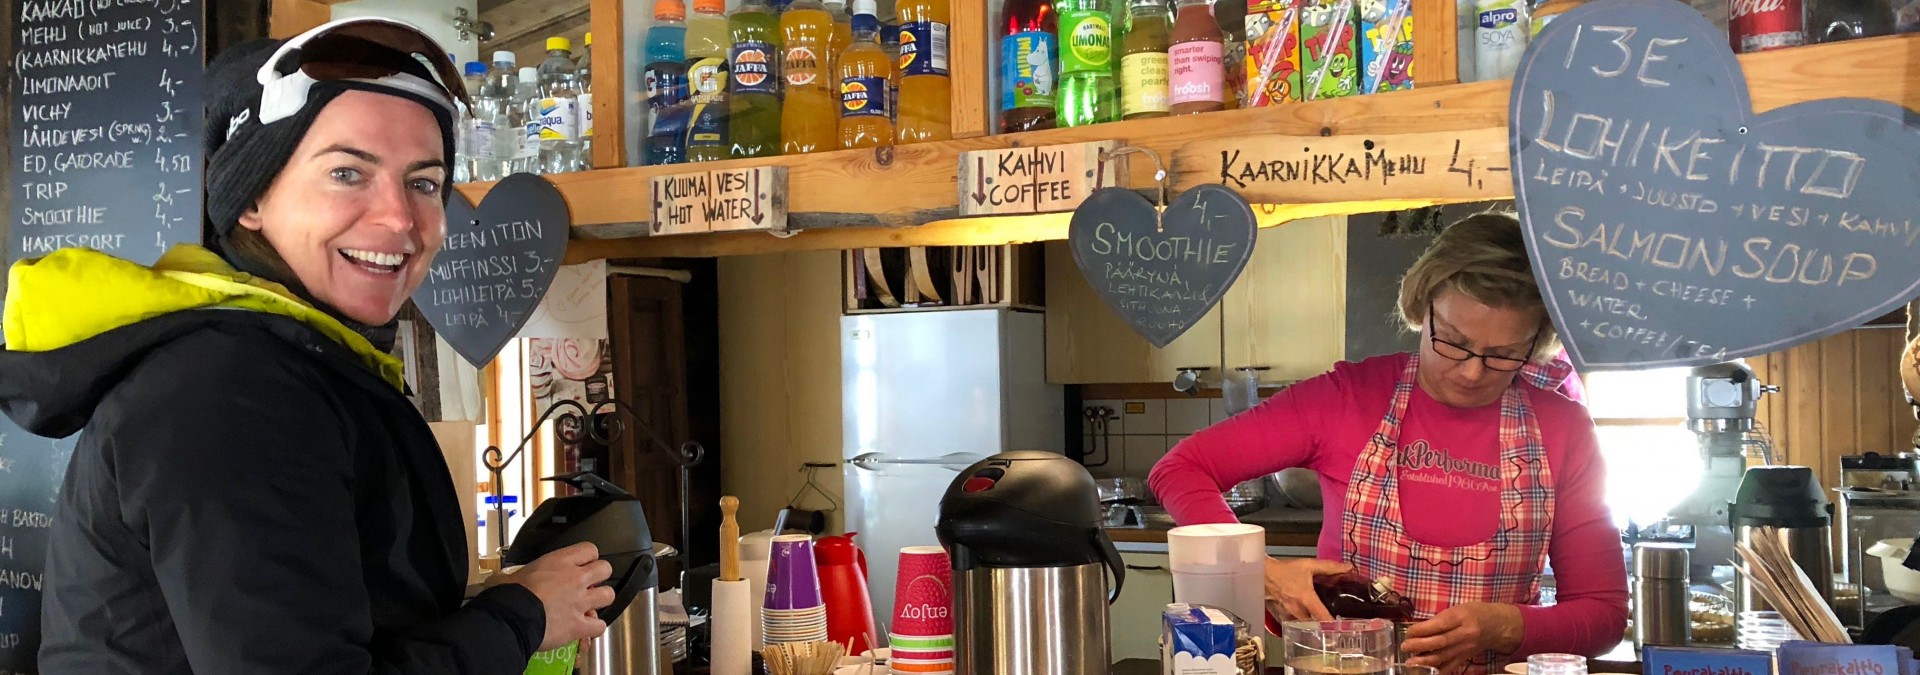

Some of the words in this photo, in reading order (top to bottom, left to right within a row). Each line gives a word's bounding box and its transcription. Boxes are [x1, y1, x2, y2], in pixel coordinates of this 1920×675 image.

[1481, 9, 1515, 25] alpro
[21, 25, 67, 46] MEHU
[1481, 29, 1515, 45] SOYA
[1173, 45, 1205, 56] smarter
[1174, 55, 1190, 65] than
[1192, 54, 1221, 65] swiping
[734, 63, 768, 73] JAFFA
[785, 58, 817, 70] JAFFA
[1141, 66, 1167, 75] clean
[1174, 64, 1194, 75] right.
[159, 68, 184, 97] 4,-
[1174, 80, 1211, 96] froosh
[843, 91, 869, 101] JAFFA
[22, 101, 72, 123] VICHY
[1534, 88, 1867, 200] LOHIKEITTO
[55, 151, 135, 173] GATORADE
[998, 150, 1064, 177] KAHVI
[22, 182, 69, 200] TRIP
[664, 175, 707, 202] KUUMA
[716, 170, 749, 195] VESI
[989, 179, 1071, 206] COFFEE
[668, 204, 694, 226] HOT
[702, 197, 752, 223] WATER
[1631, 181, 1718, 214] JUUSTO
[1751, 202, 1810, 227] VESI
[21, 206, 108, 227] SMOOTHIE
[1091, 222, 1237, 266] SMOOTHIE
[1542, 205, 1729, 277] SALMON
[1732, 235, 1878, 287] SOUP
[429, 254, 518, 285] MUFFINSSI
[1559, 255, 1629, 291] BREAD
[1652, 279, 1734, 306] CHEESE
[433, 278, 517, 306] LOHILEIPÄ
[1567, 289, 1648, 321] WATER
[445, 308, 489, 329] LEIPÄ
[899, 602, 948, 623] enjoy
